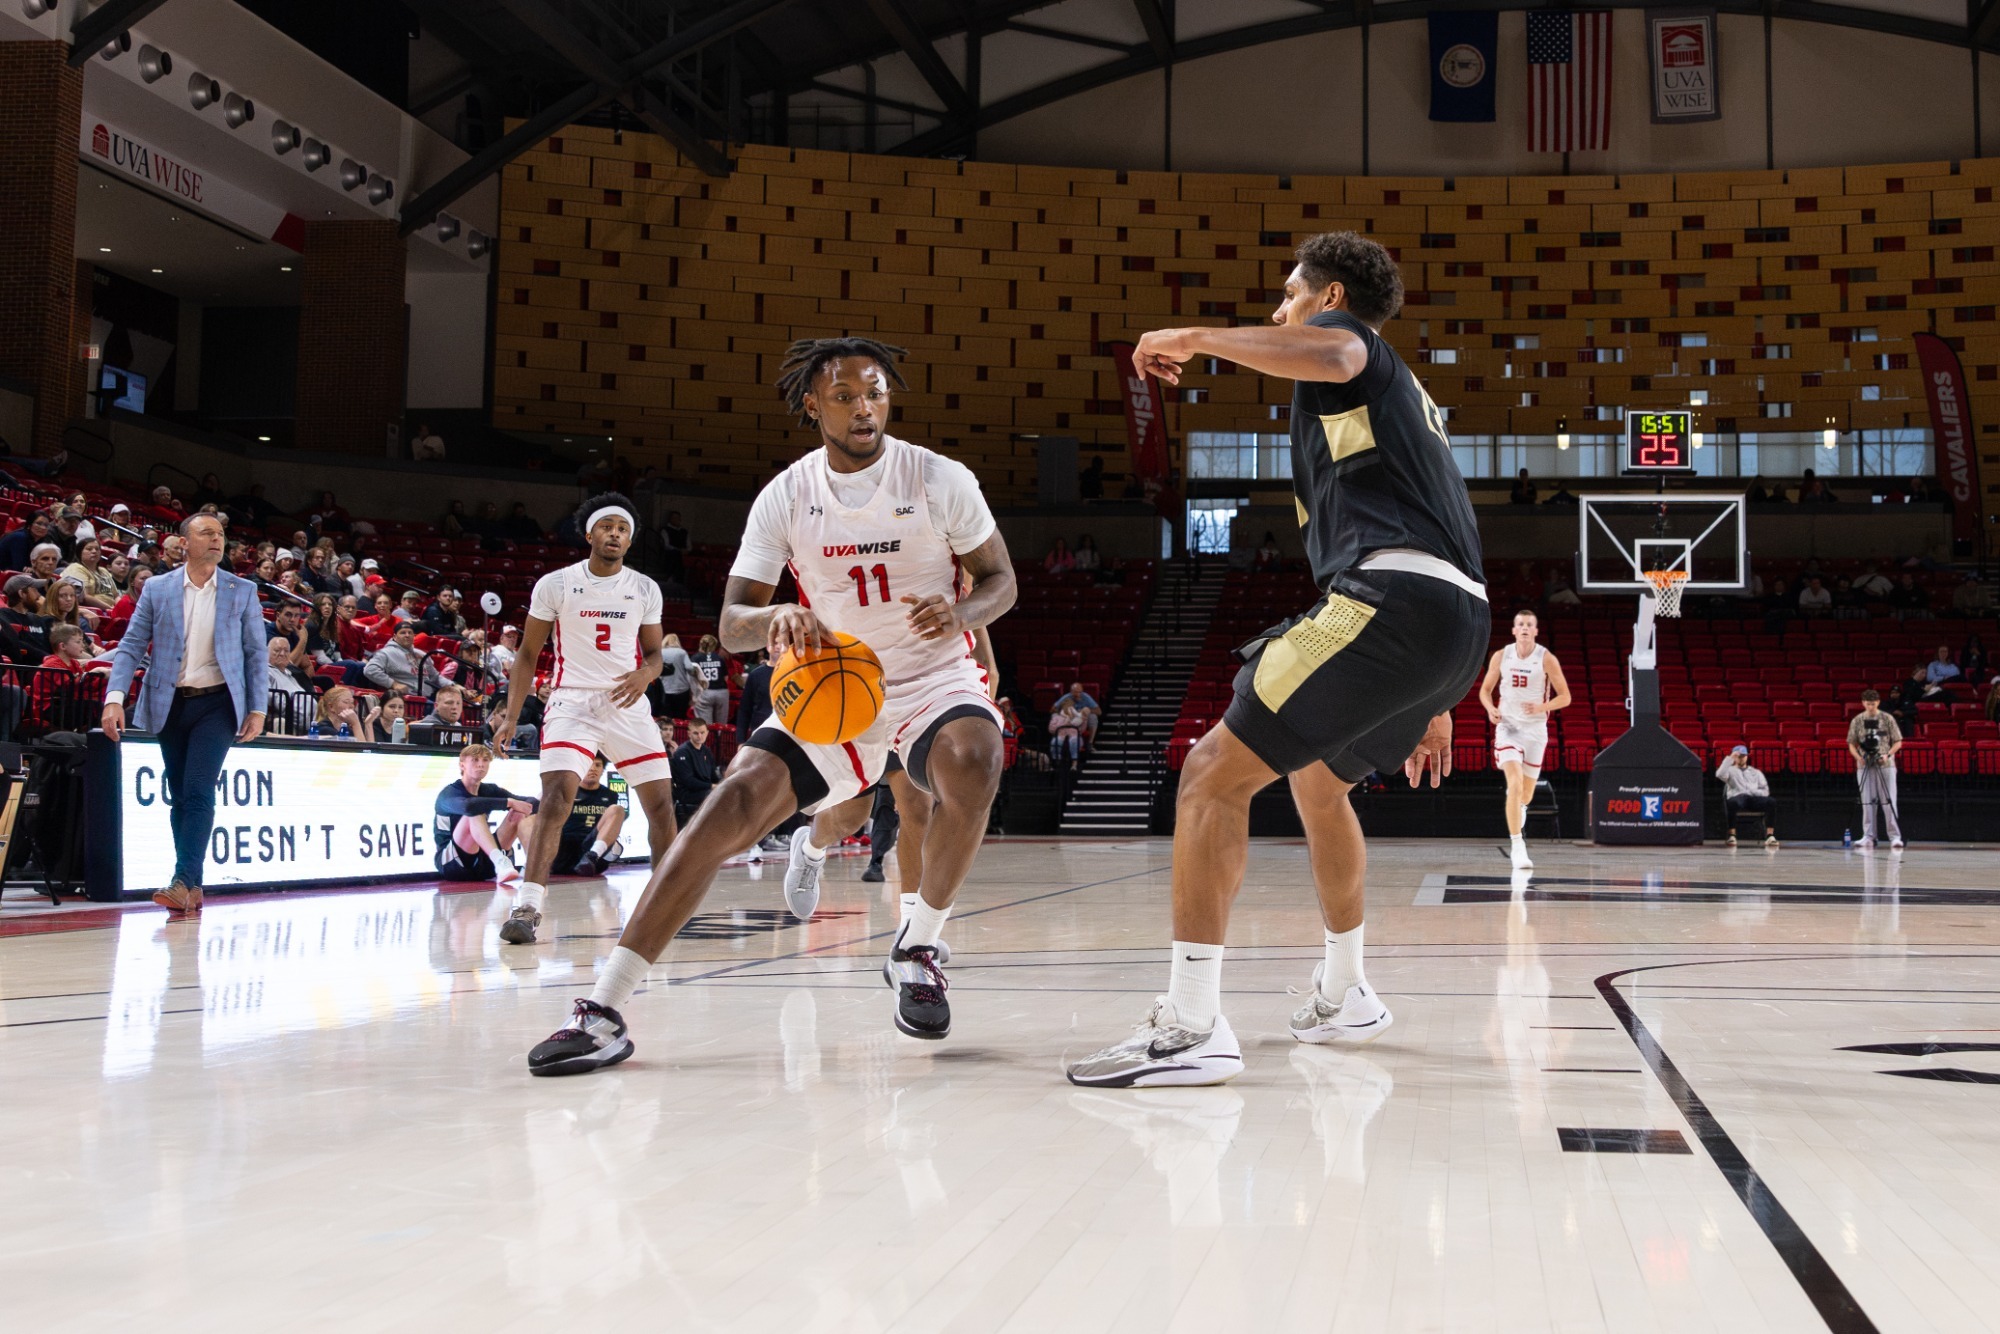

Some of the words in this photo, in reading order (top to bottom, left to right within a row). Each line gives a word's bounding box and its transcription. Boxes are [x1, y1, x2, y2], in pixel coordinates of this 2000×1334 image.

[1664, 71, 1705, 89] UVA
[1664, 93, 1707, 108] WISE
[112, 133, 151, 179] UVA
[154, 153, 203, 203] WISE
[1641, 416, 1684, 433] 15:51
[1933, 371, 1969, 502] CAVALIERS
[1641, 434, 1678, 464] 25
[895, 506, 915, 516] SAC
[823, 540, 901, 557] UVAWISE
[847, 563, 891, 606] 11
[580, 610, 627, 619] UVAWISE
[595, 623, 611, 652] 2
[704, 668, 718, 680] 33
[1512, 674, 1527, 687] 33
[136, 766, 273, 806] COMON
[609, 782, 627, 793] ARMY
[573, 805, 608, 814] ANDERSO
[1607, 800, 1641, 814] FOOD
[1662, 800, 1690, 814] CITY
[212, 825, 335, 865] OESN'T
[359, 823, 424, 858] SAVE
